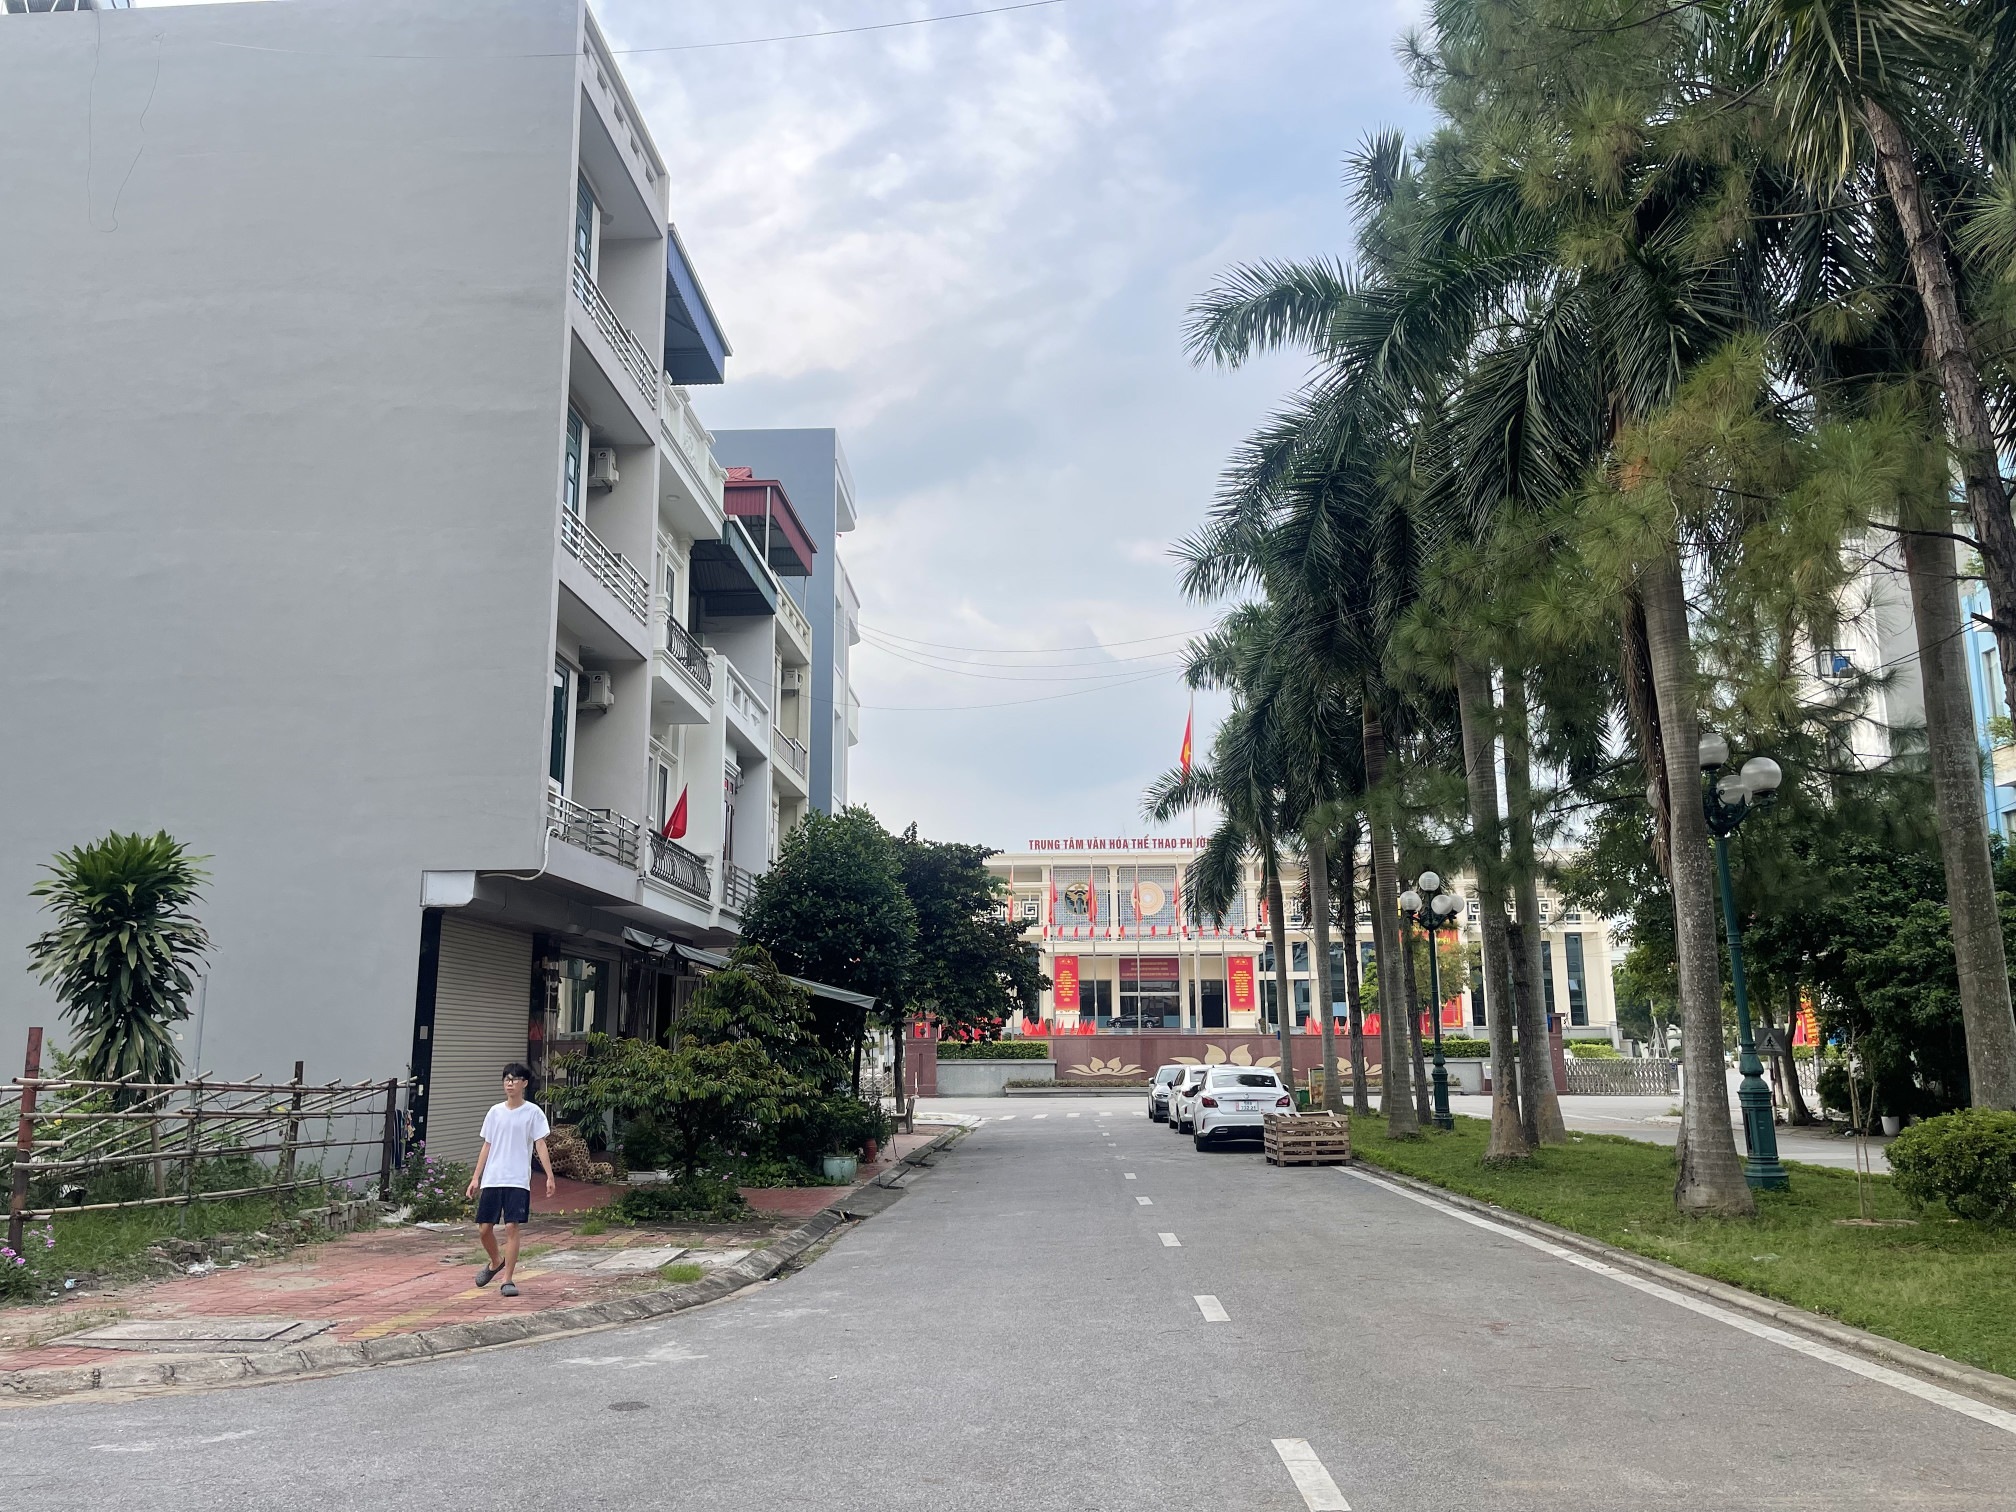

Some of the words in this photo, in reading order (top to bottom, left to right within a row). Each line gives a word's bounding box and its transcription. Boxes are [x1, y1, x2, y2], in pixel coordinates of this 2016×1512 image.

[1028, 839, 1060, 850] TRUNG
[1063, 836, 1084, 850] TÂM
[1087, 836, 1106, 850] VĂN
[1109, 835, 1128, 850] HÓA
[1131, 833, 1149, 849] THỂ
[1151, 838, 1177, 849] THAO
